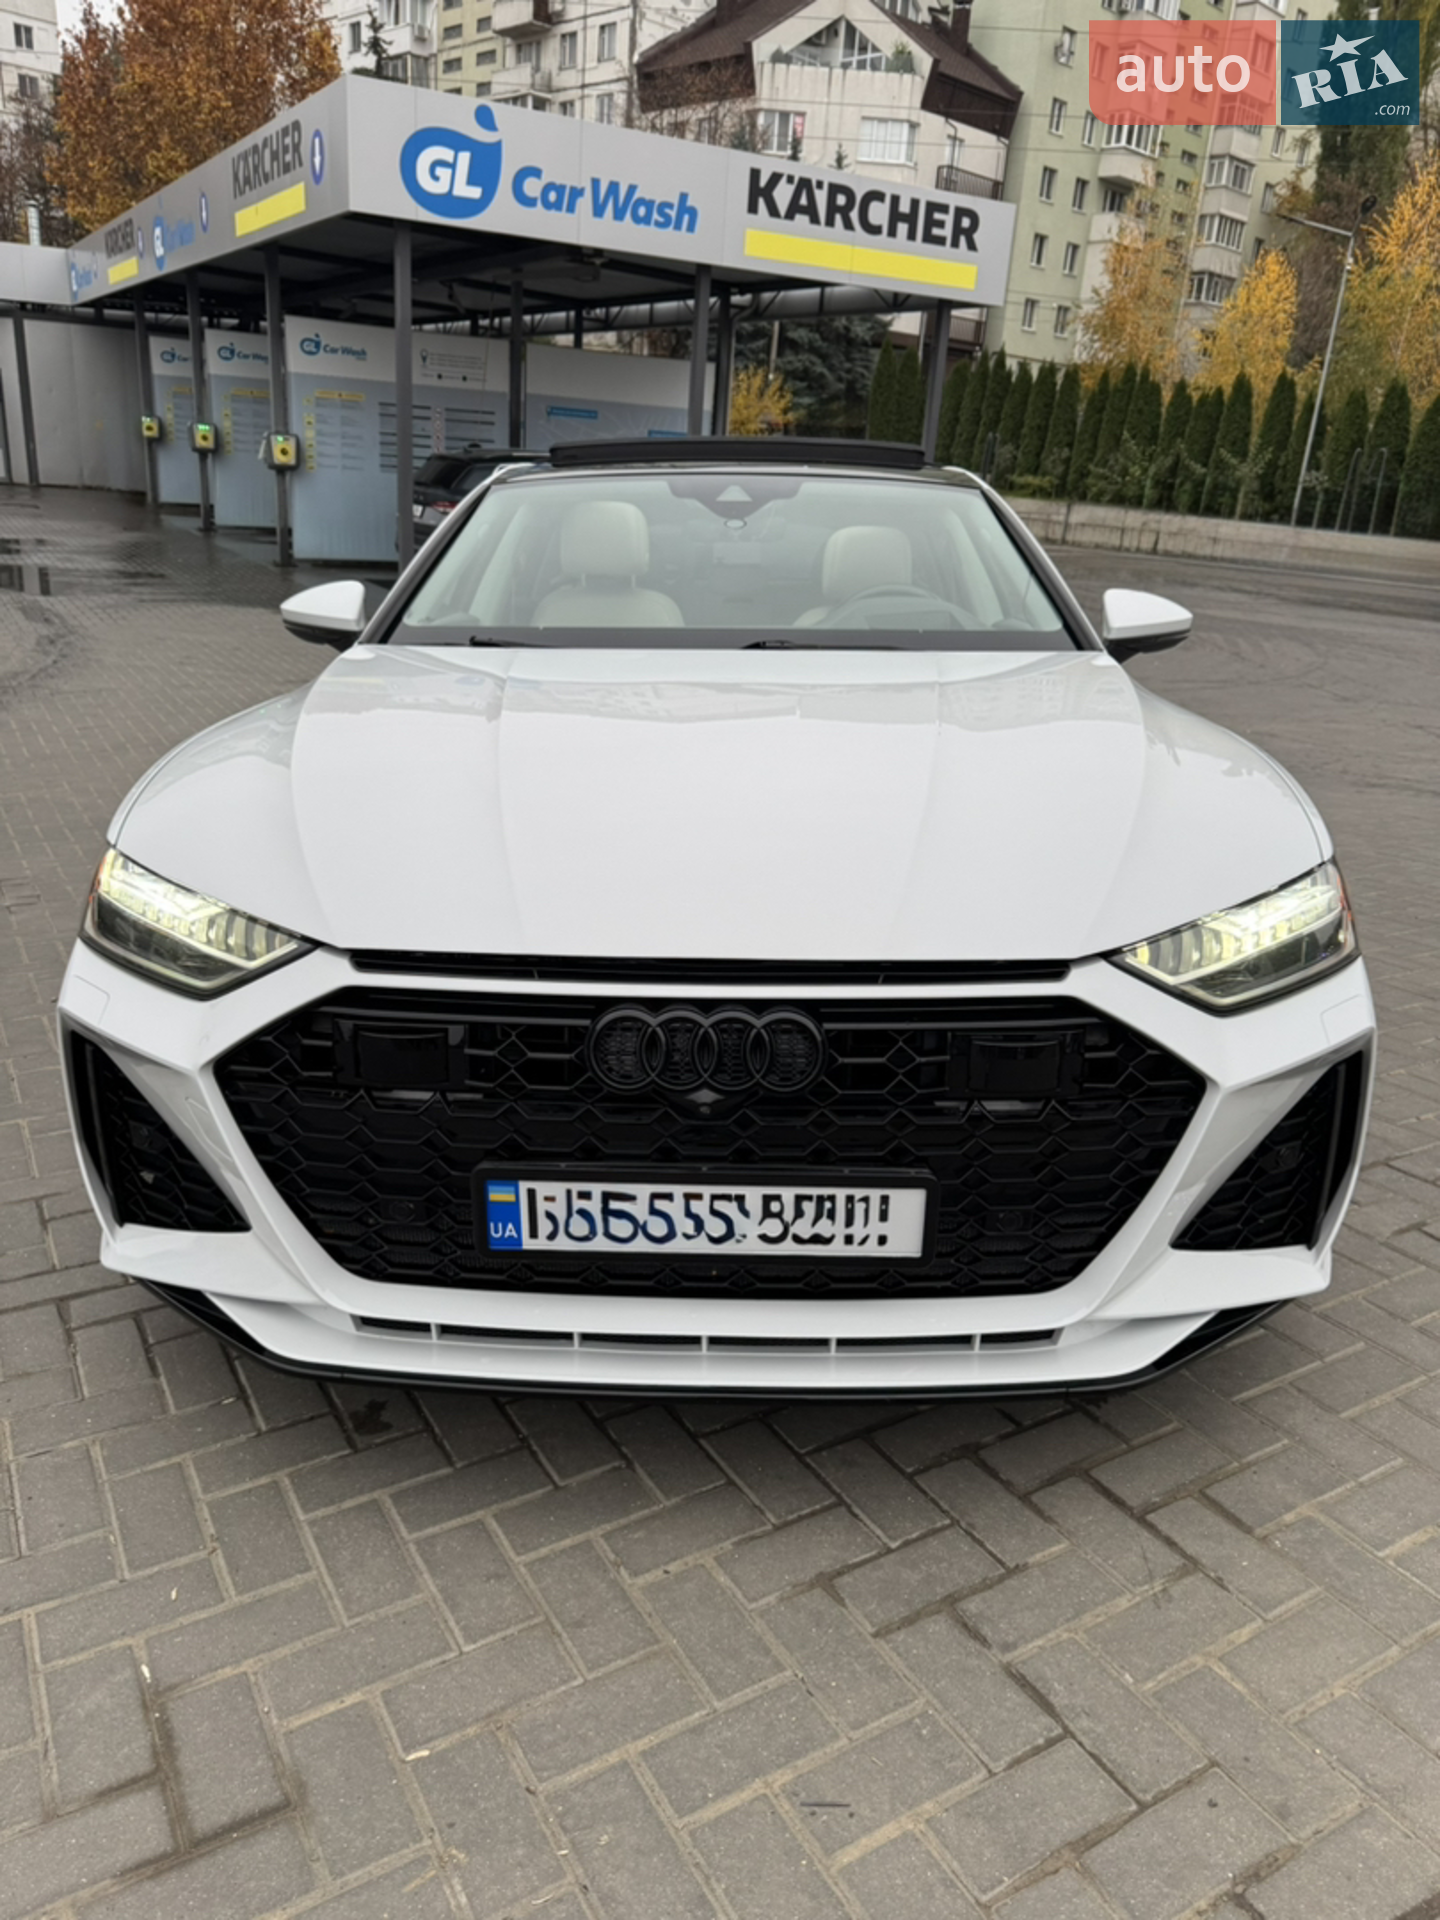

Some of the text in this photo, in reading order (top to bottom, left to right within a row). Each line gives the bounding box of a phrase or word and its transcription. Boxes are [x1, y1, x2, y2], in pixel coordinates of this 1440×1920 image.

[232, 119, 303, 199] KÄRCHER
[415, 145, 699, 234] GL Car Wash
[747, 167, 981, 252] KÄRCHER
[490, 1222, 518, 1239] UA
